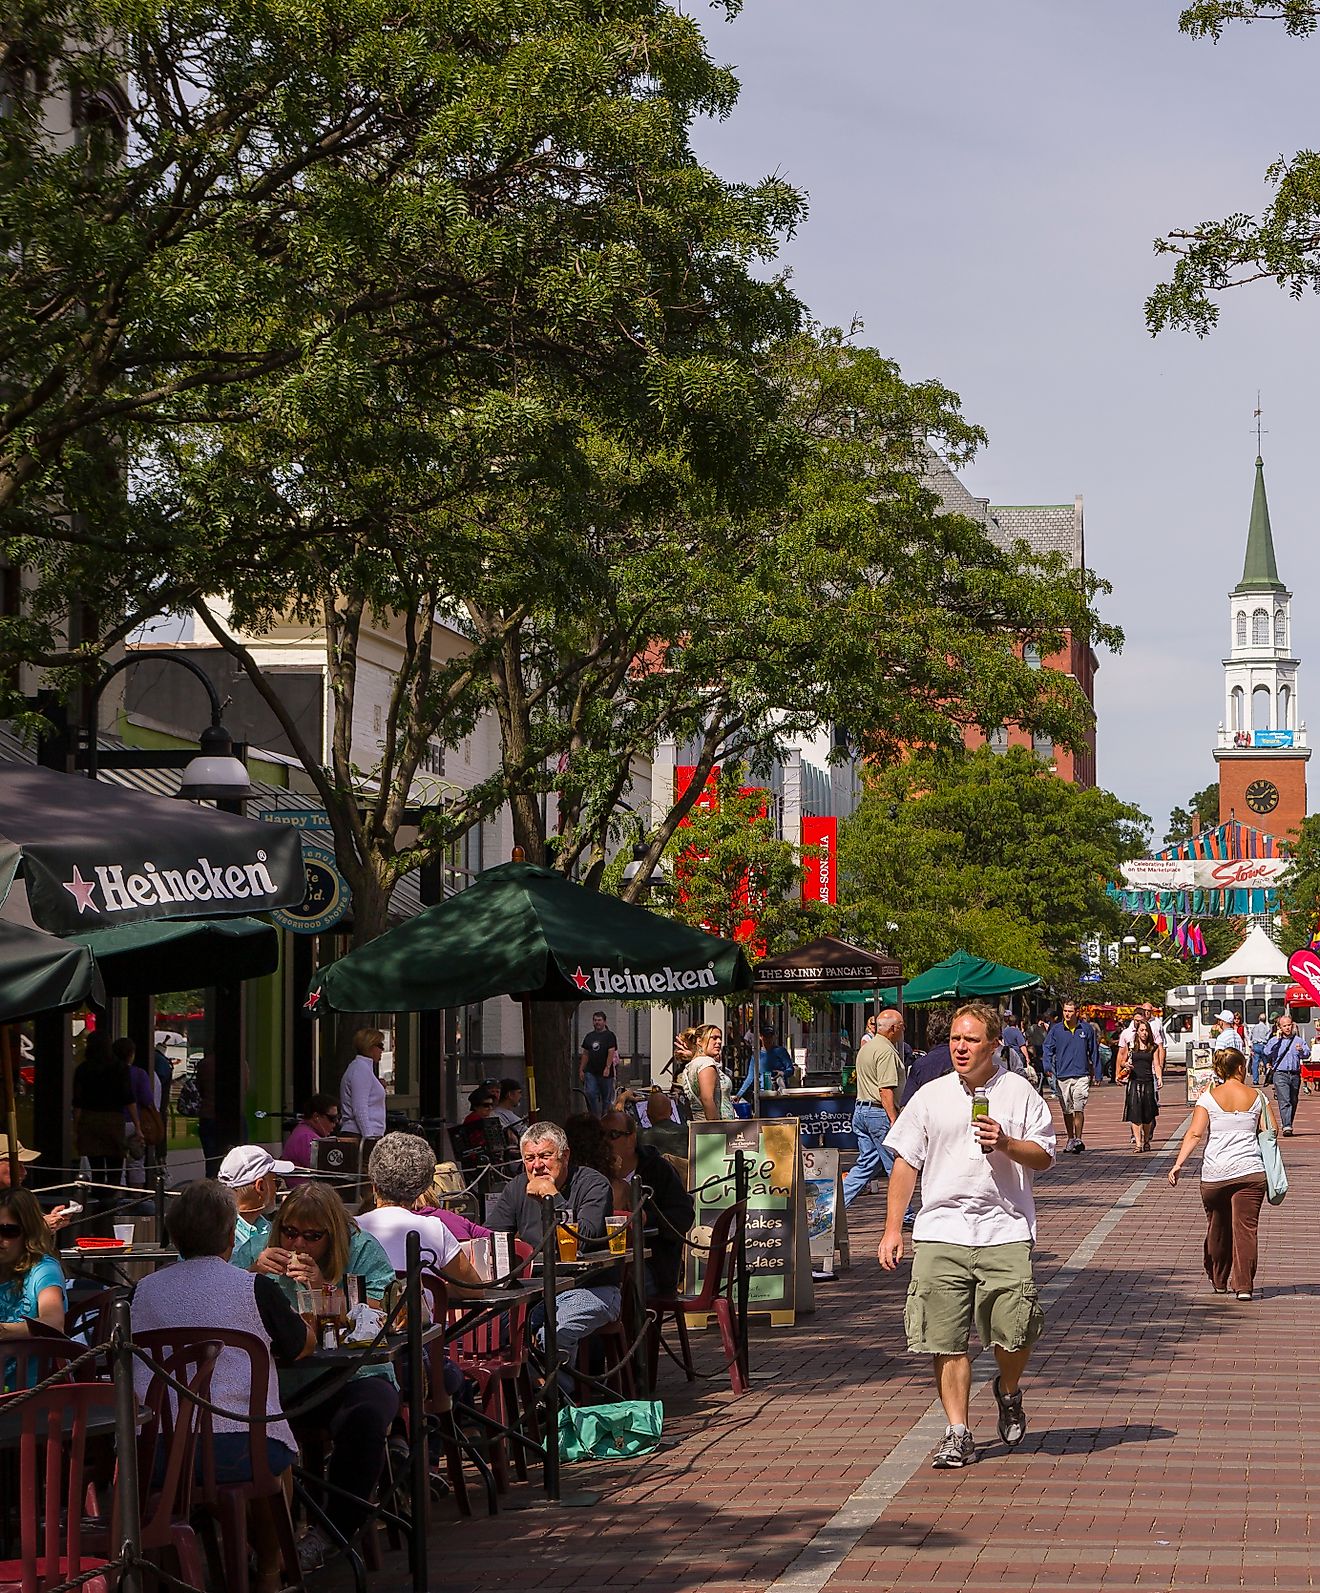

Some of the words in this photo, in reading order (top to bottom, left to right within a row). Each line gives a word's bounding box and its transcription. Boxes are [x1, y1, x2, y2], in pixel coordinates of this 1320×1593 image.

[264, 814, 307, 826] Happy
[310, 814, 331, 825] Tra
[1211, 859, 1277, 889] Stowe
[758, 969, 783, 979] THE
[783, 967, 824, 978] SKINNY
[825, 966, 873, 977] PANCAKE
[820, 1110, 852, 1121] Savory
[800, 1121, 853, 1135] REPES
[699, 1174, 790, 1204] Cram
[745, 1214, 783, 1229] hakes
